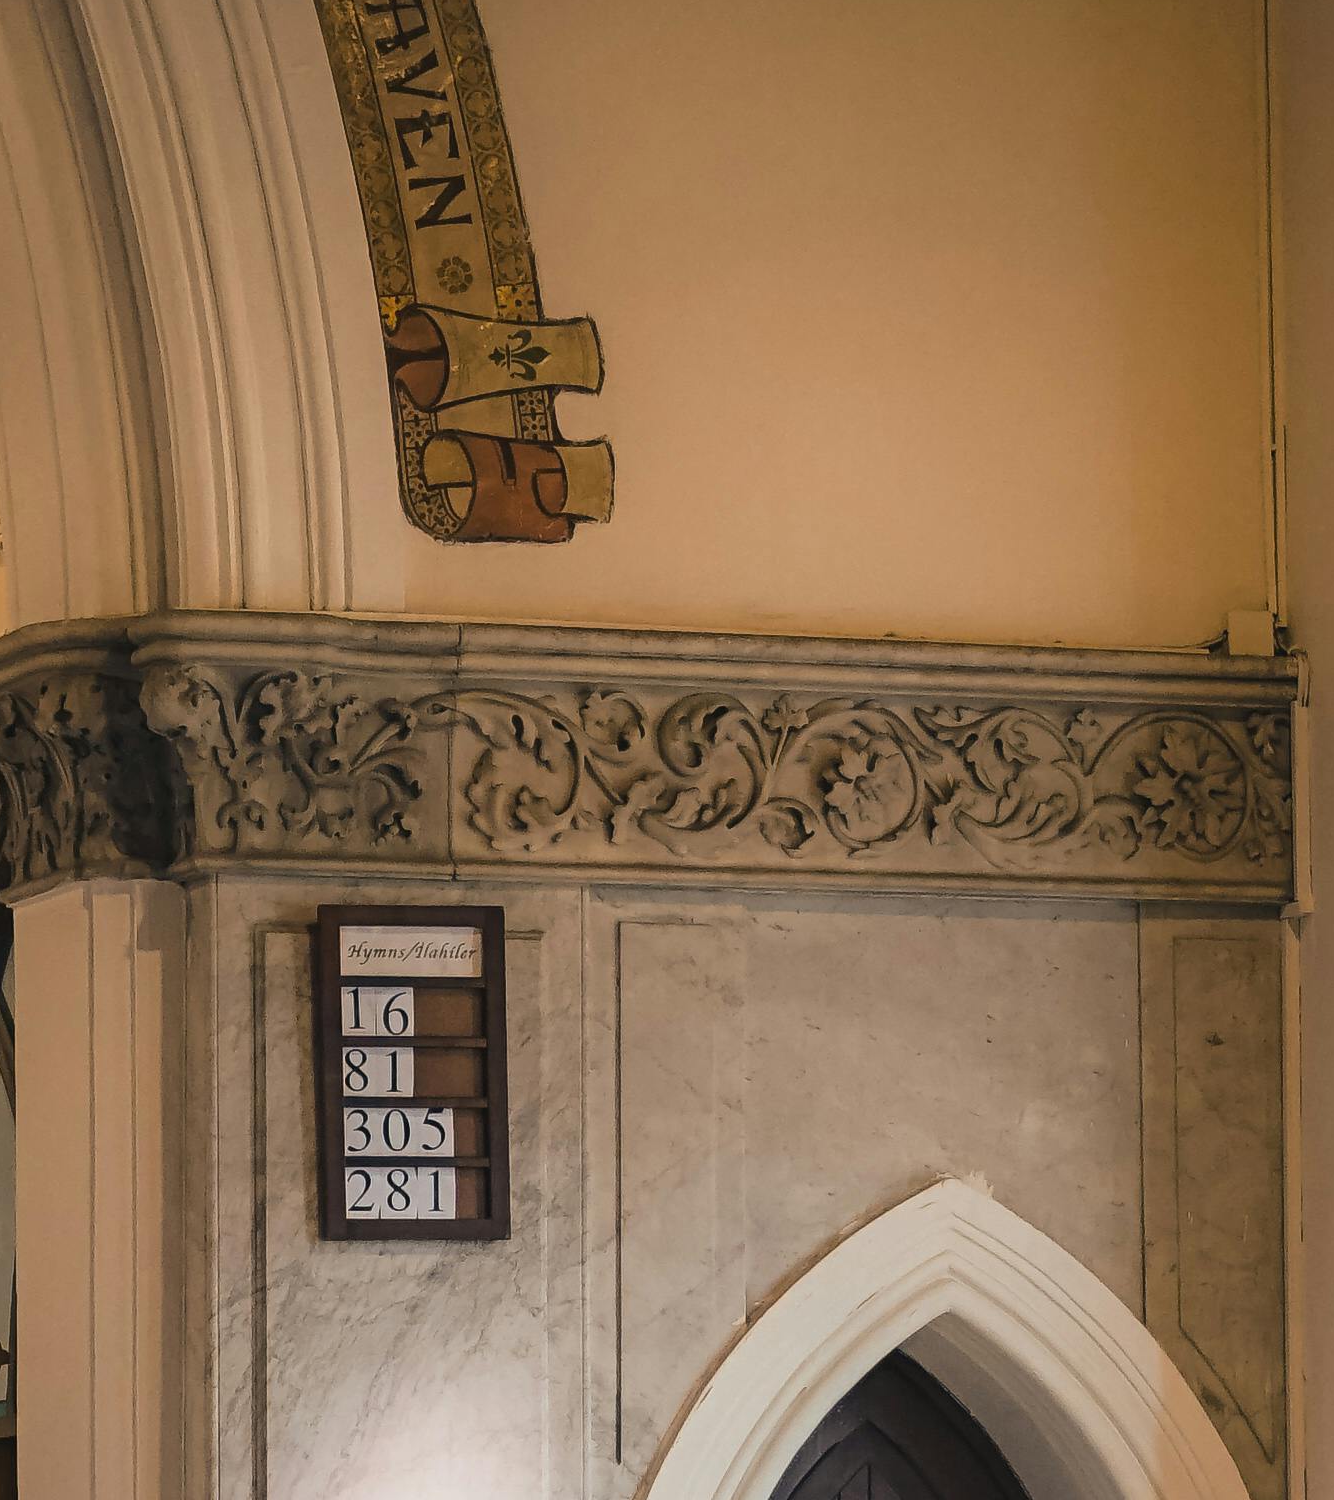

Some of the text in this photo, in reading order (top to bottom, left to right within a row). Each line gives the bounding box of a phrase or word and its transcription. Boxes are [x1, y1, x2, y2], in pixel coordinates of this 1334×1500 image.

[347, 988, 409, 1036] 16
[344, 1049, 403, 1093] 81
[348, 1108, 445, 1152] 305
[347, 1169, 444, 1213] 281
